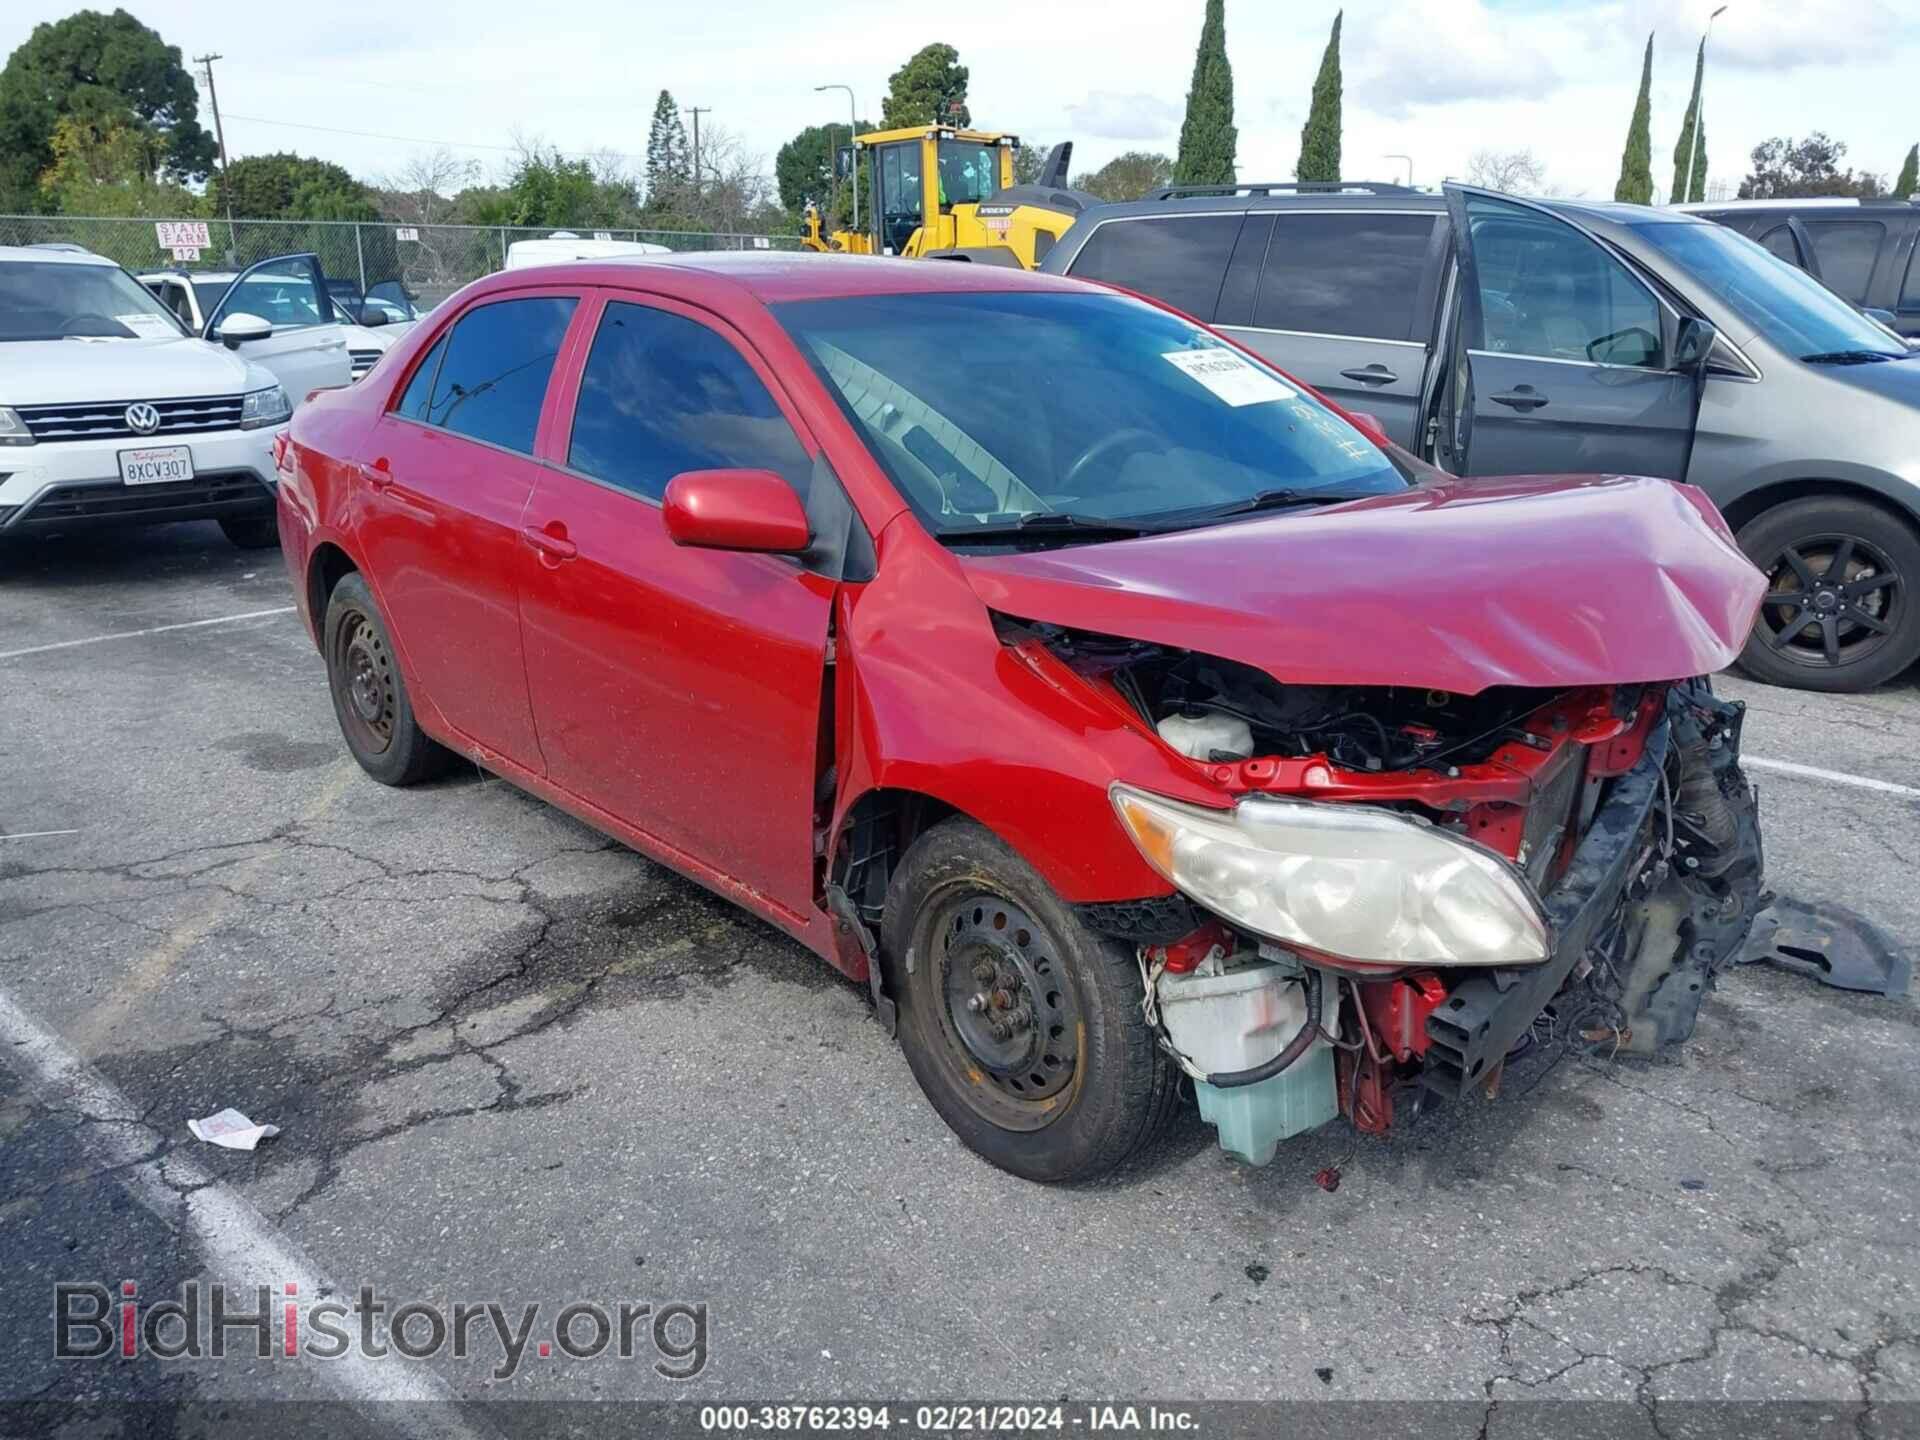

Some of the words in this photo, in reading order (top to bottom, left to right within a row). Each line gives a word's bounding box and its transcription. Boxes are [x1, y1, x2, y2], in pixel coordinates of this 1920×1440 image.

[160, 223, 206, 234] STATE
[164, 233, 207, 244] FARM
[178, 248, 195, 260] 12
[127, 460, 187, 480] 8XCV307
